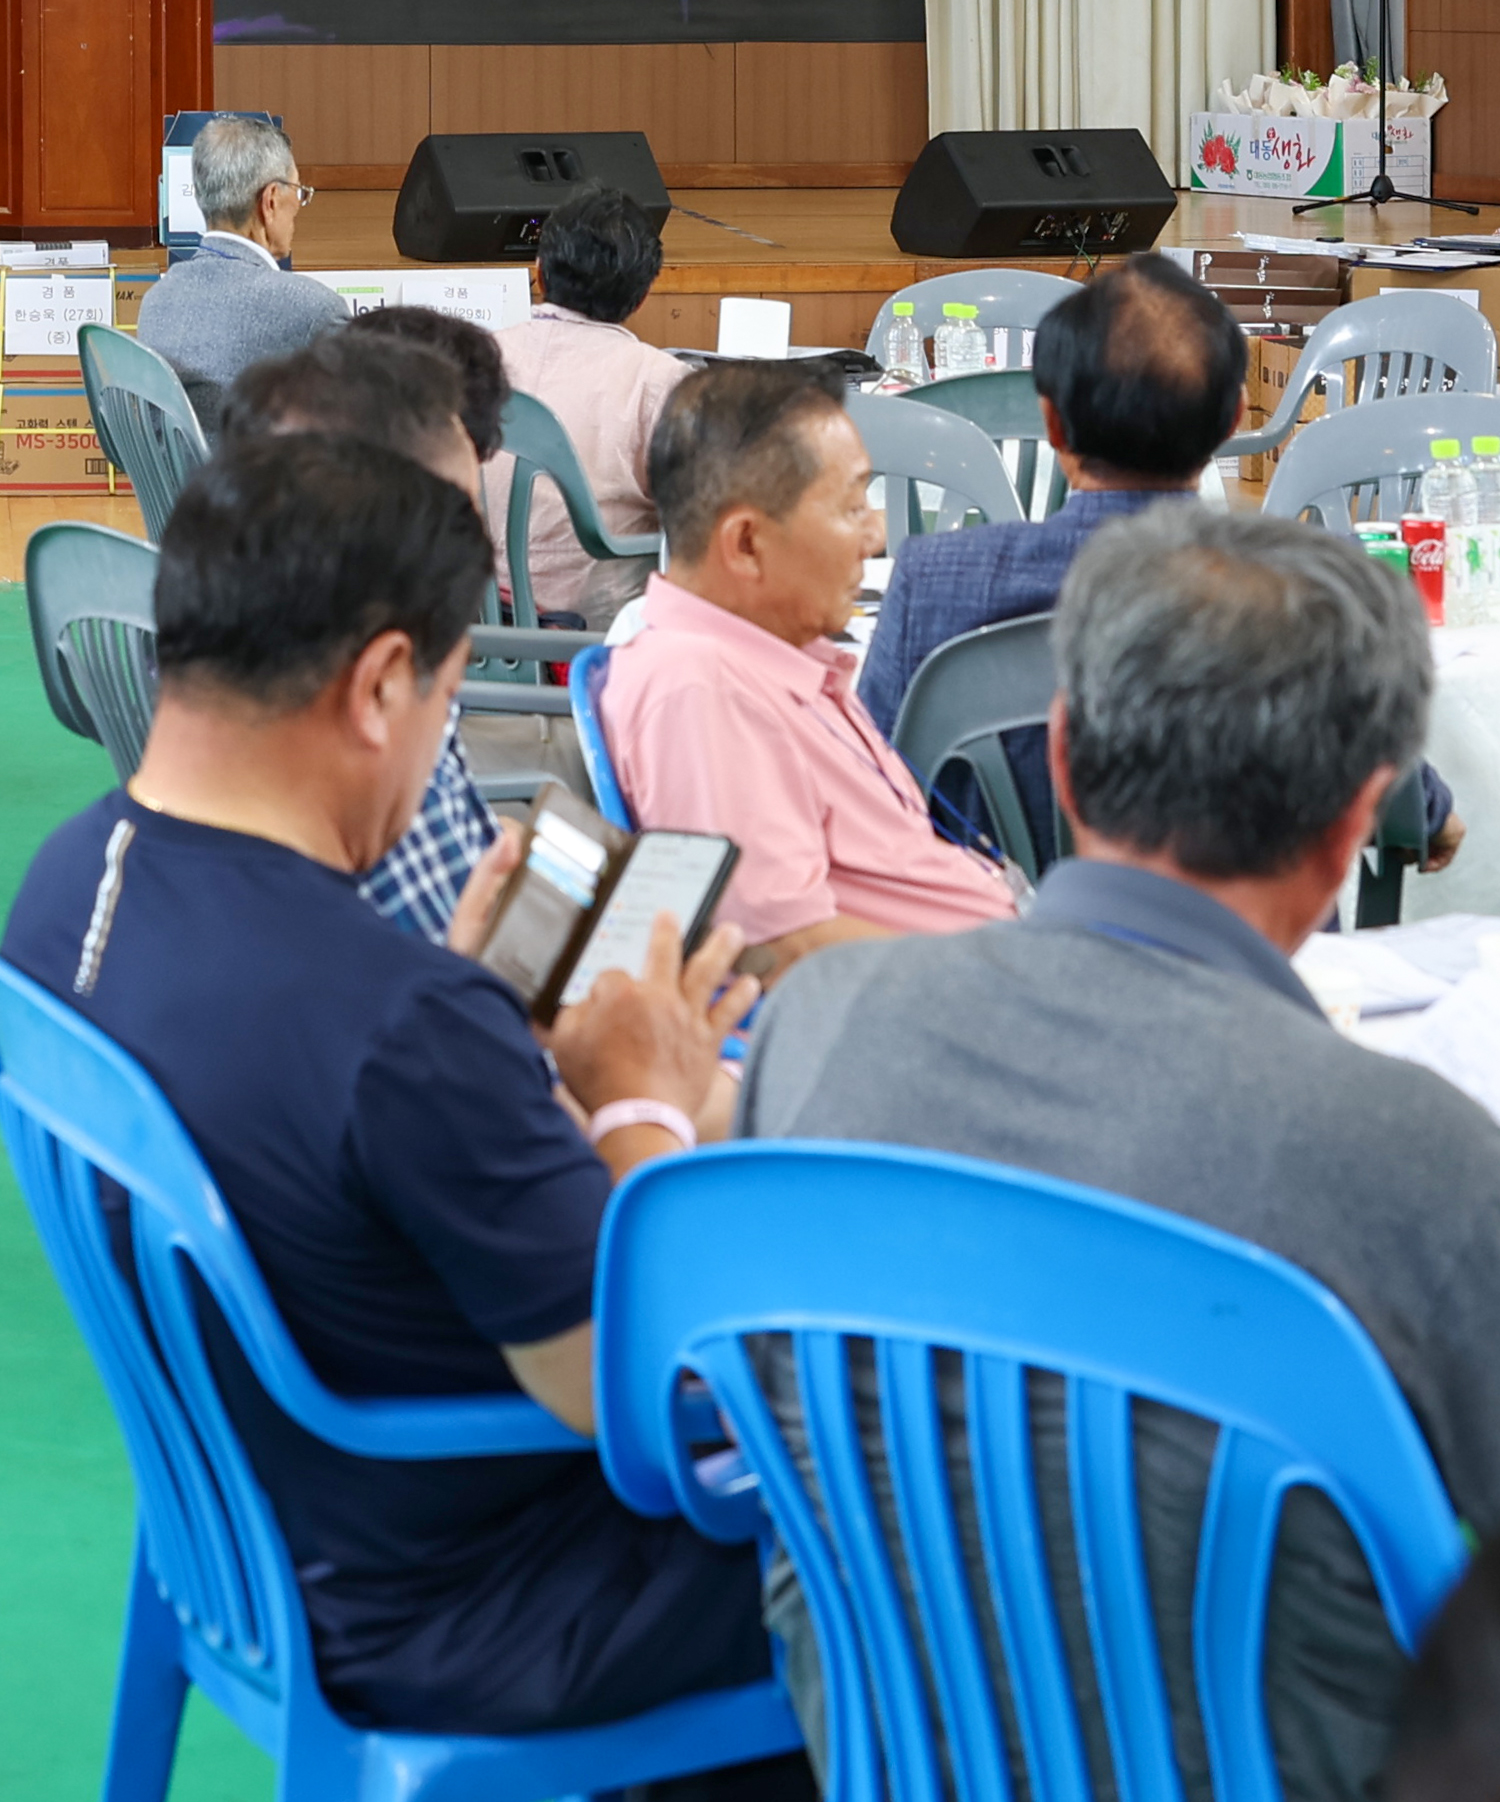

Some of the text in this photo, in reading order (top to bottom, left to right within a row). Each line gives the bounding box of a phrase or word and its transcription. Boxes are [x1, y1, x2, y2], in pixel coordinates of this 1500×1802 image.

[14, 308, 104, 322] 한승욱 (27회)
[47, 331, 71, 345] (증)
